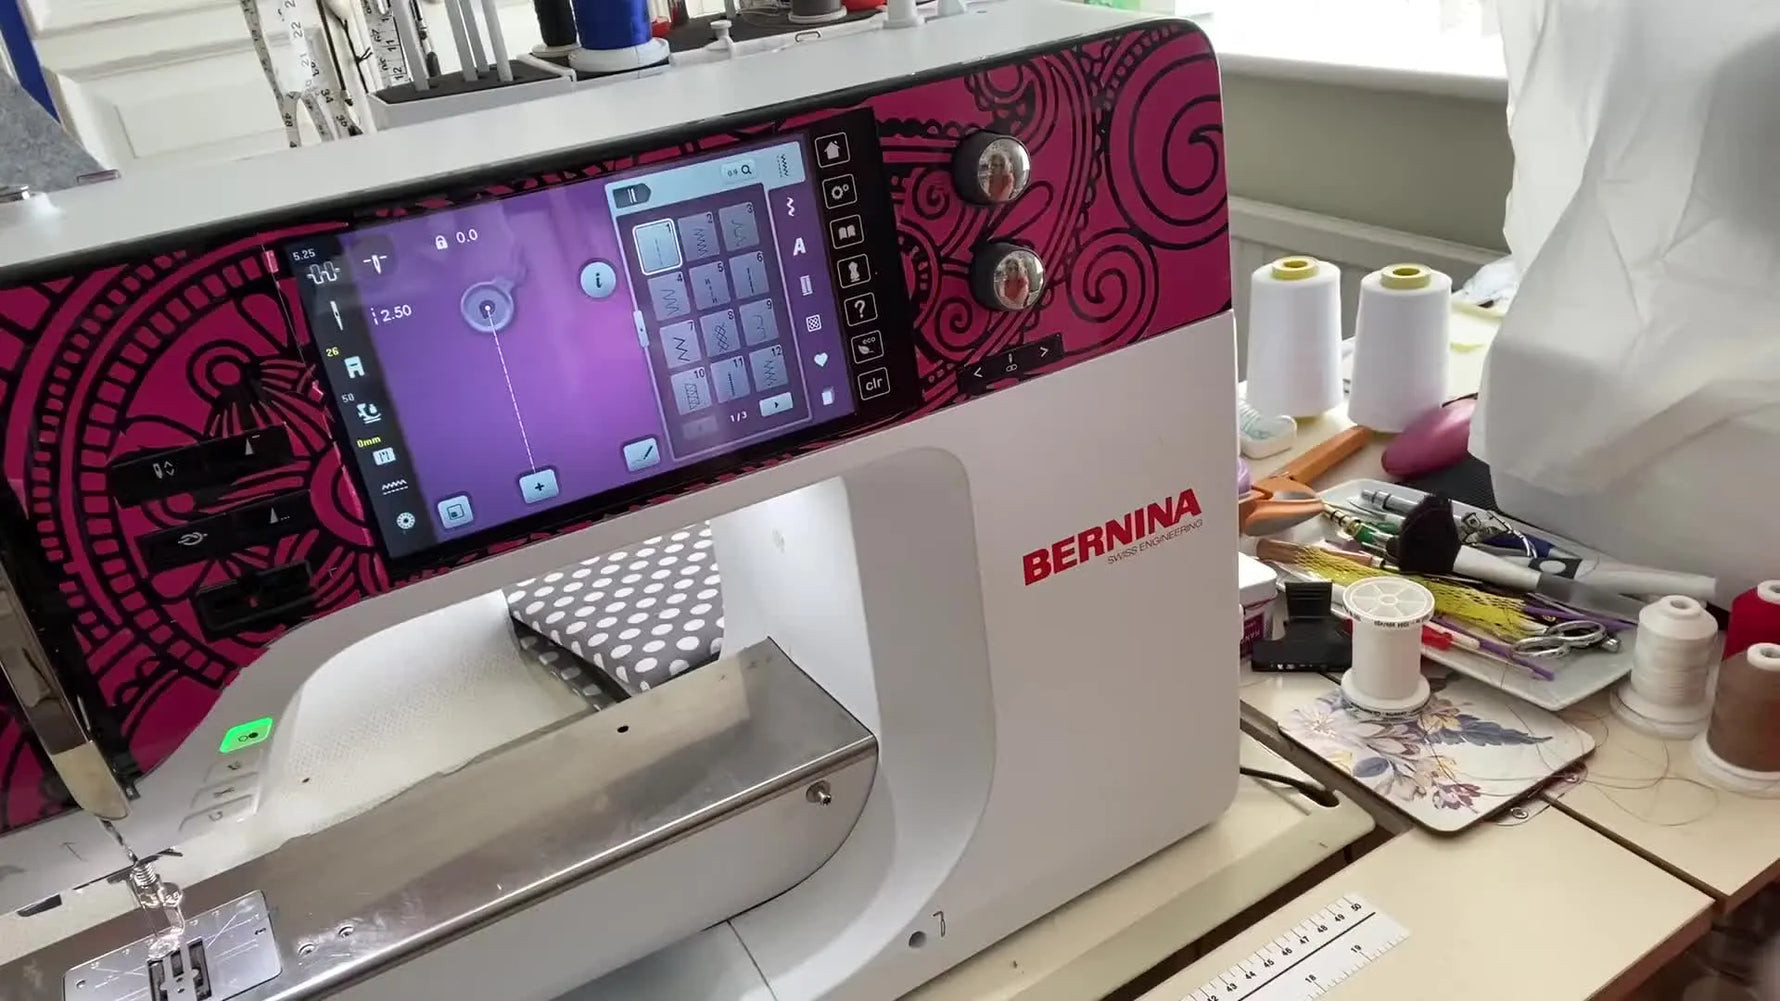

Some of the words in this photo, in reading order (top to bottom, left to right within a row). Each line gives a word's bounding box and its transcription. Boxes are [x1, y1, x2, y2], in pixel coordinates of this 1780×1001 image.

[746, 203, 754, 214] 3
[706, 213, 713, 224] 2
[456, 228, 478, 244] 0.0
[292, 248, 316, 261] 5.25
[756, 252, 764, 263] 6
[717, 262, 724, 273] 5
[676, 273, 683, 283] 4
[766, 299, 773, 310] 9
[380, 304, 412, 322] 2.50
[727, 310, 734, 321] 8
[862, 335, 876, 344] eco
[325, 347, 340, 358] 26
[771, 345, 783, 358] 12
[733, 357, 744, 369] 11
[693, 368, 706, 379] 10
[865, 375, 884, 392] clr
[341, 392, 356, 404] 50
[730, 410, 748, 423] 1/3
[356, 435, 382, 449] 0mm
[1022, 488, 1202, 586] BERNINA
[1107, 545, 1139, 565] SWISS
[1138, 517, 1204, 553] ENGINEERING
[1350, 902, 1363, 912] 50
